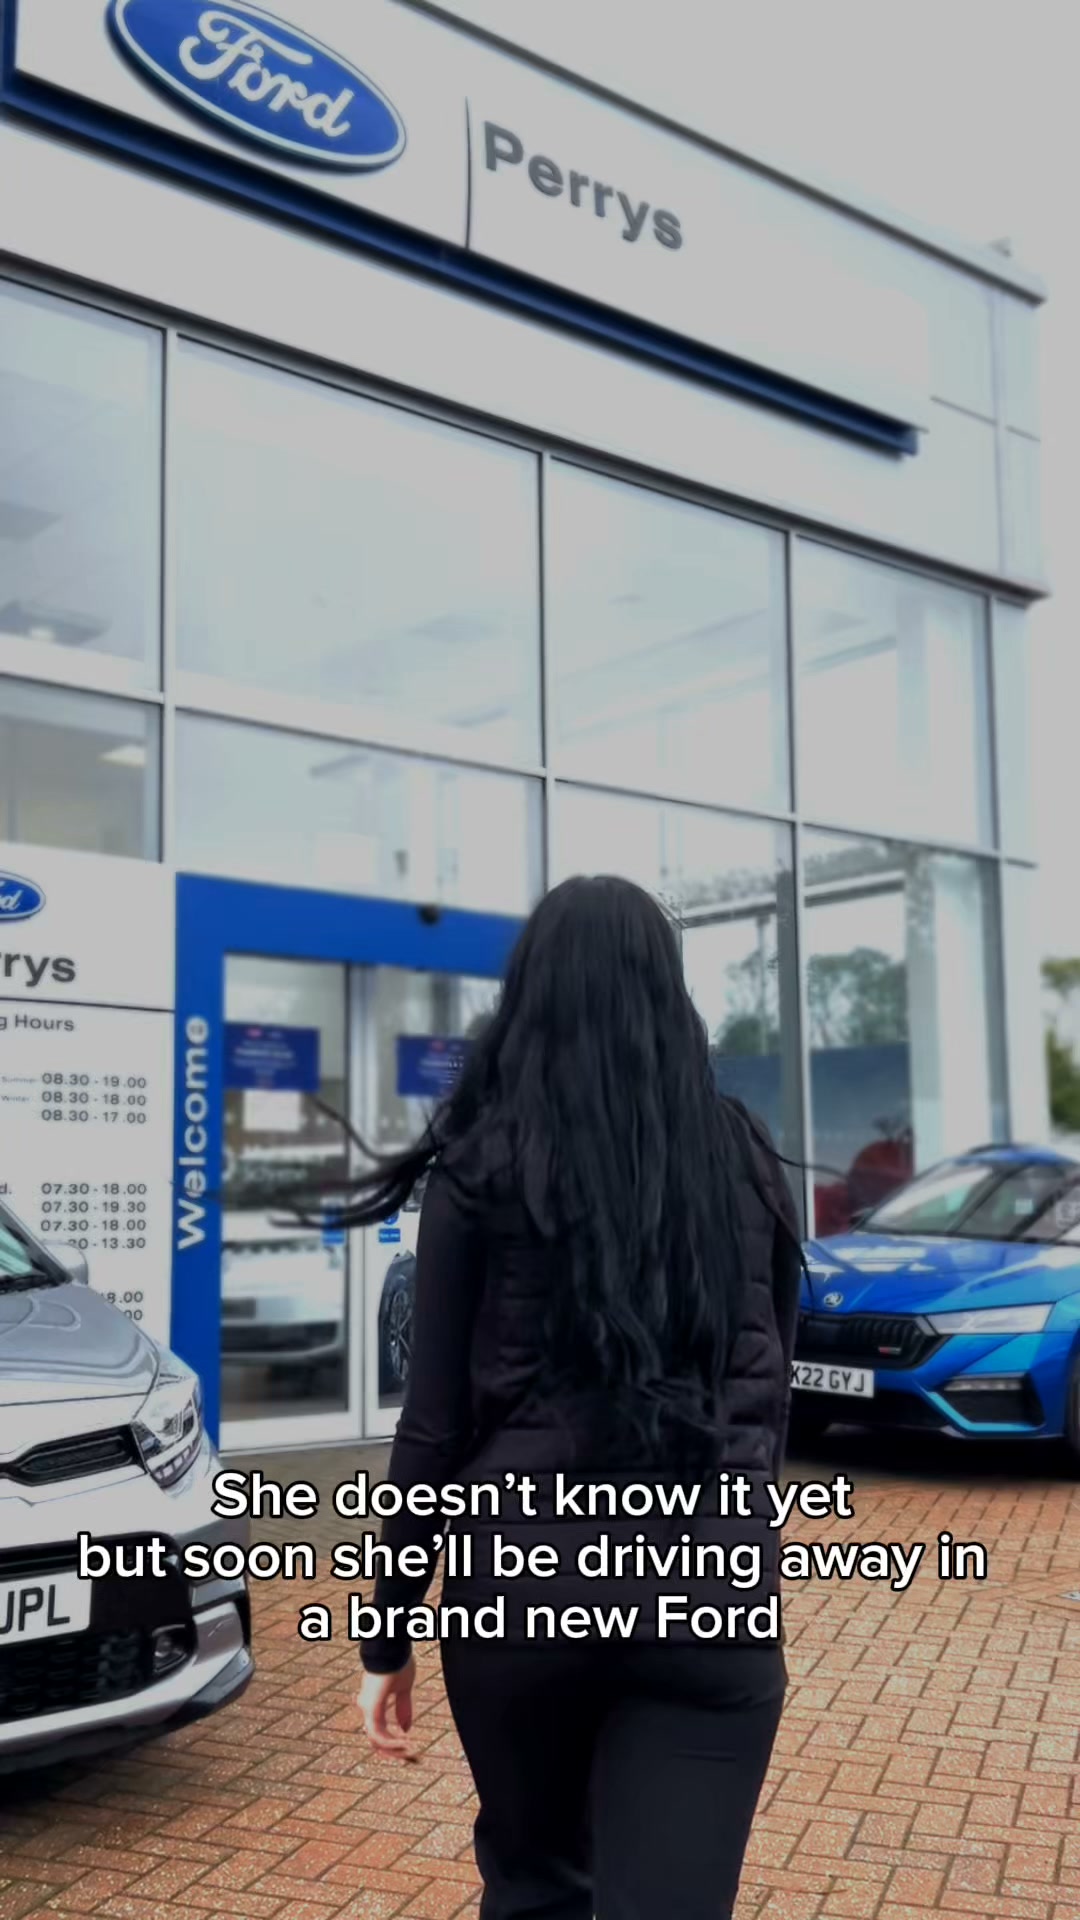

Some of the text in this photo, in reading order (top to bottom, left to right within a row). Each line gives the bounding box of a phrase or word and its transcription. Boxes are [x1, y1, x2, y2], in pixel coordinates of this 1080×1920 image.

[179, 10, 354, 137] Ford
[484, 120, 683, 250] Perrys
[0, 952, 76, 987] rys
[15, 1014, 75, 1031] Hours
[178, 1015, 209, 1250] Welcome
[41, 1183, 90, 1195] 07.30
[103, 1183, 147, 1195] 18.00
[41, 1201, 89, 1213] 07.30
[41, 1220, 89, 1232] 07.30
[102, 1220, 147, 1231] 18.00
[101, 1291, 143, 1304] 8.00
[829, 1370, 865, 1393] GYJ
